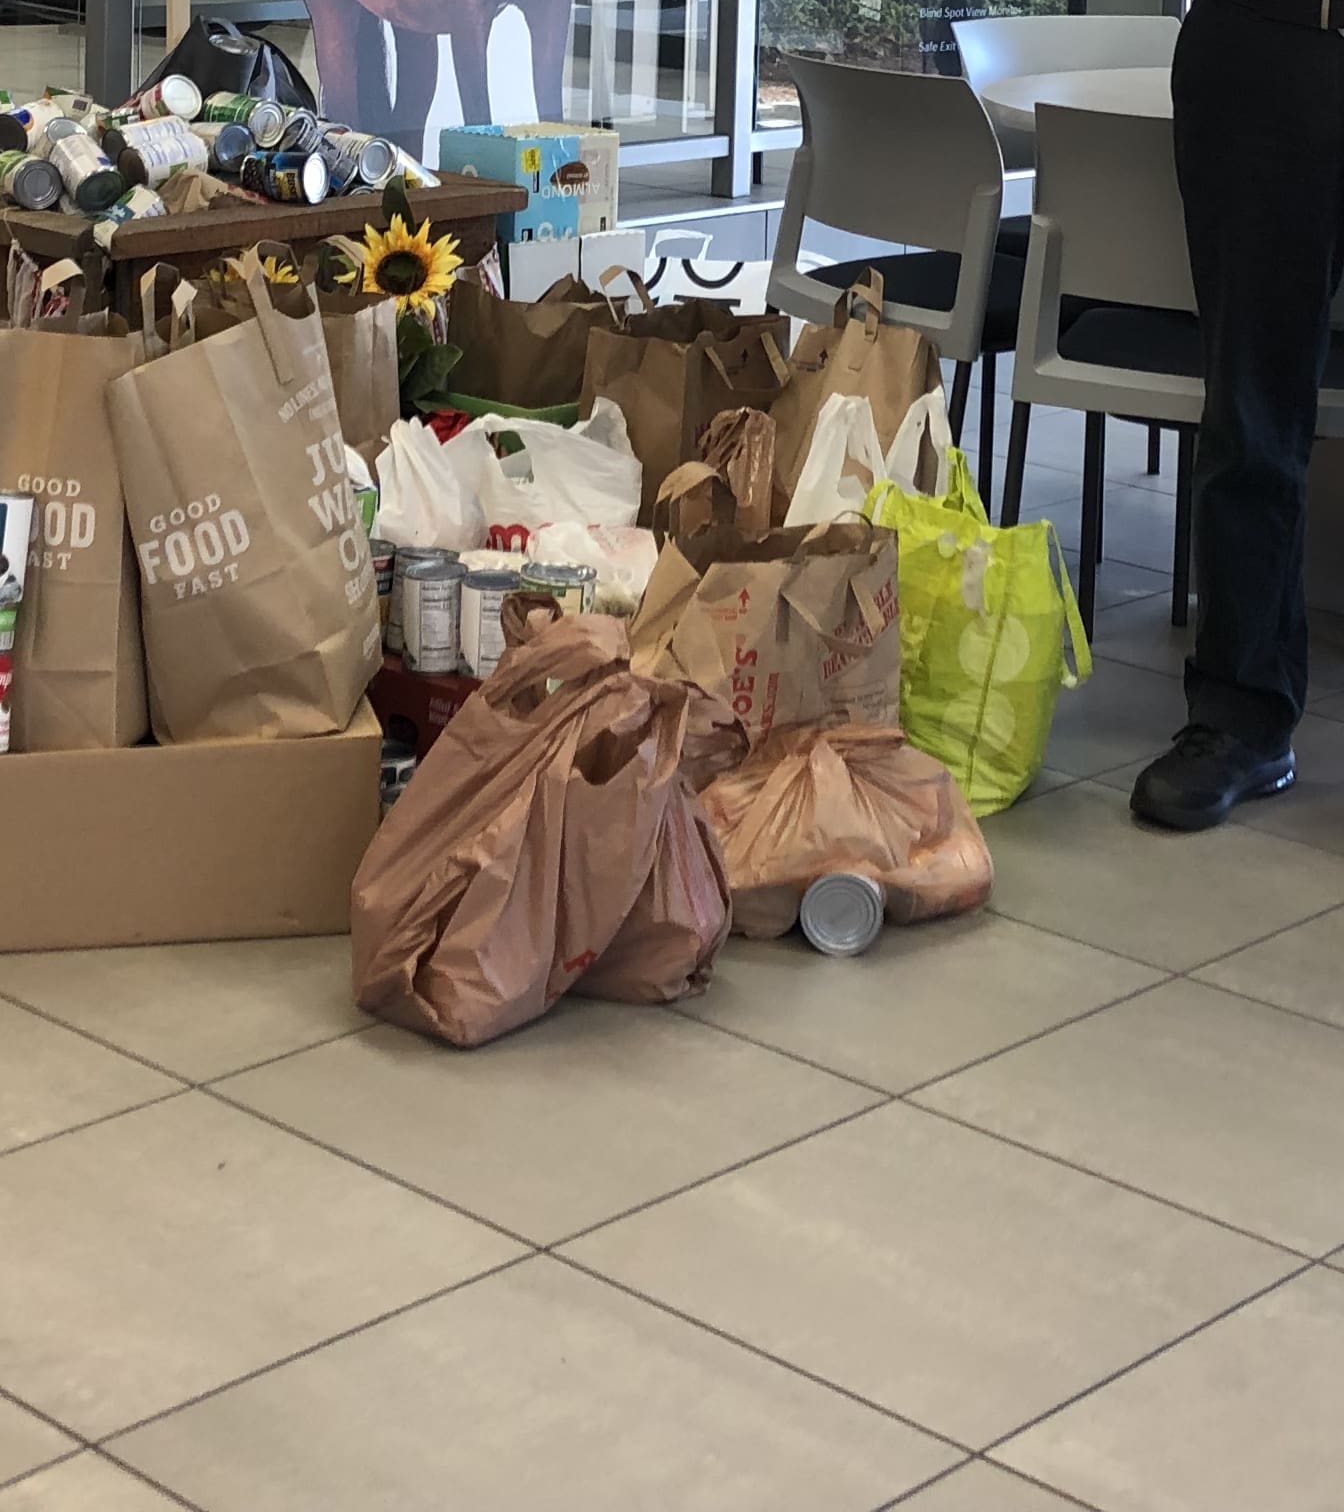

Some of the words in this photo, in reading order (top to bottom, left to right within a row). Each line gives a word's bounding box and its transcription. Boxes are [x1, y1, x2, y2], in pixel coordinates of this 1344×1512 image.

[919, 7, 943, 18] Blind
[944, 7, 964, 20] Spot
[966, 7, 987, 17] View
[918, 40, 938, 53] Safe
[939, 40, 956, 52] Exit
[541, 181, 601, 200] ALMOND
[17, 473, 81, 497] GOOD
[150, 493, 221, 534] GOOD
[138, 508, 251, 585] FOOD
[174, 562, 241, 600] FAST
